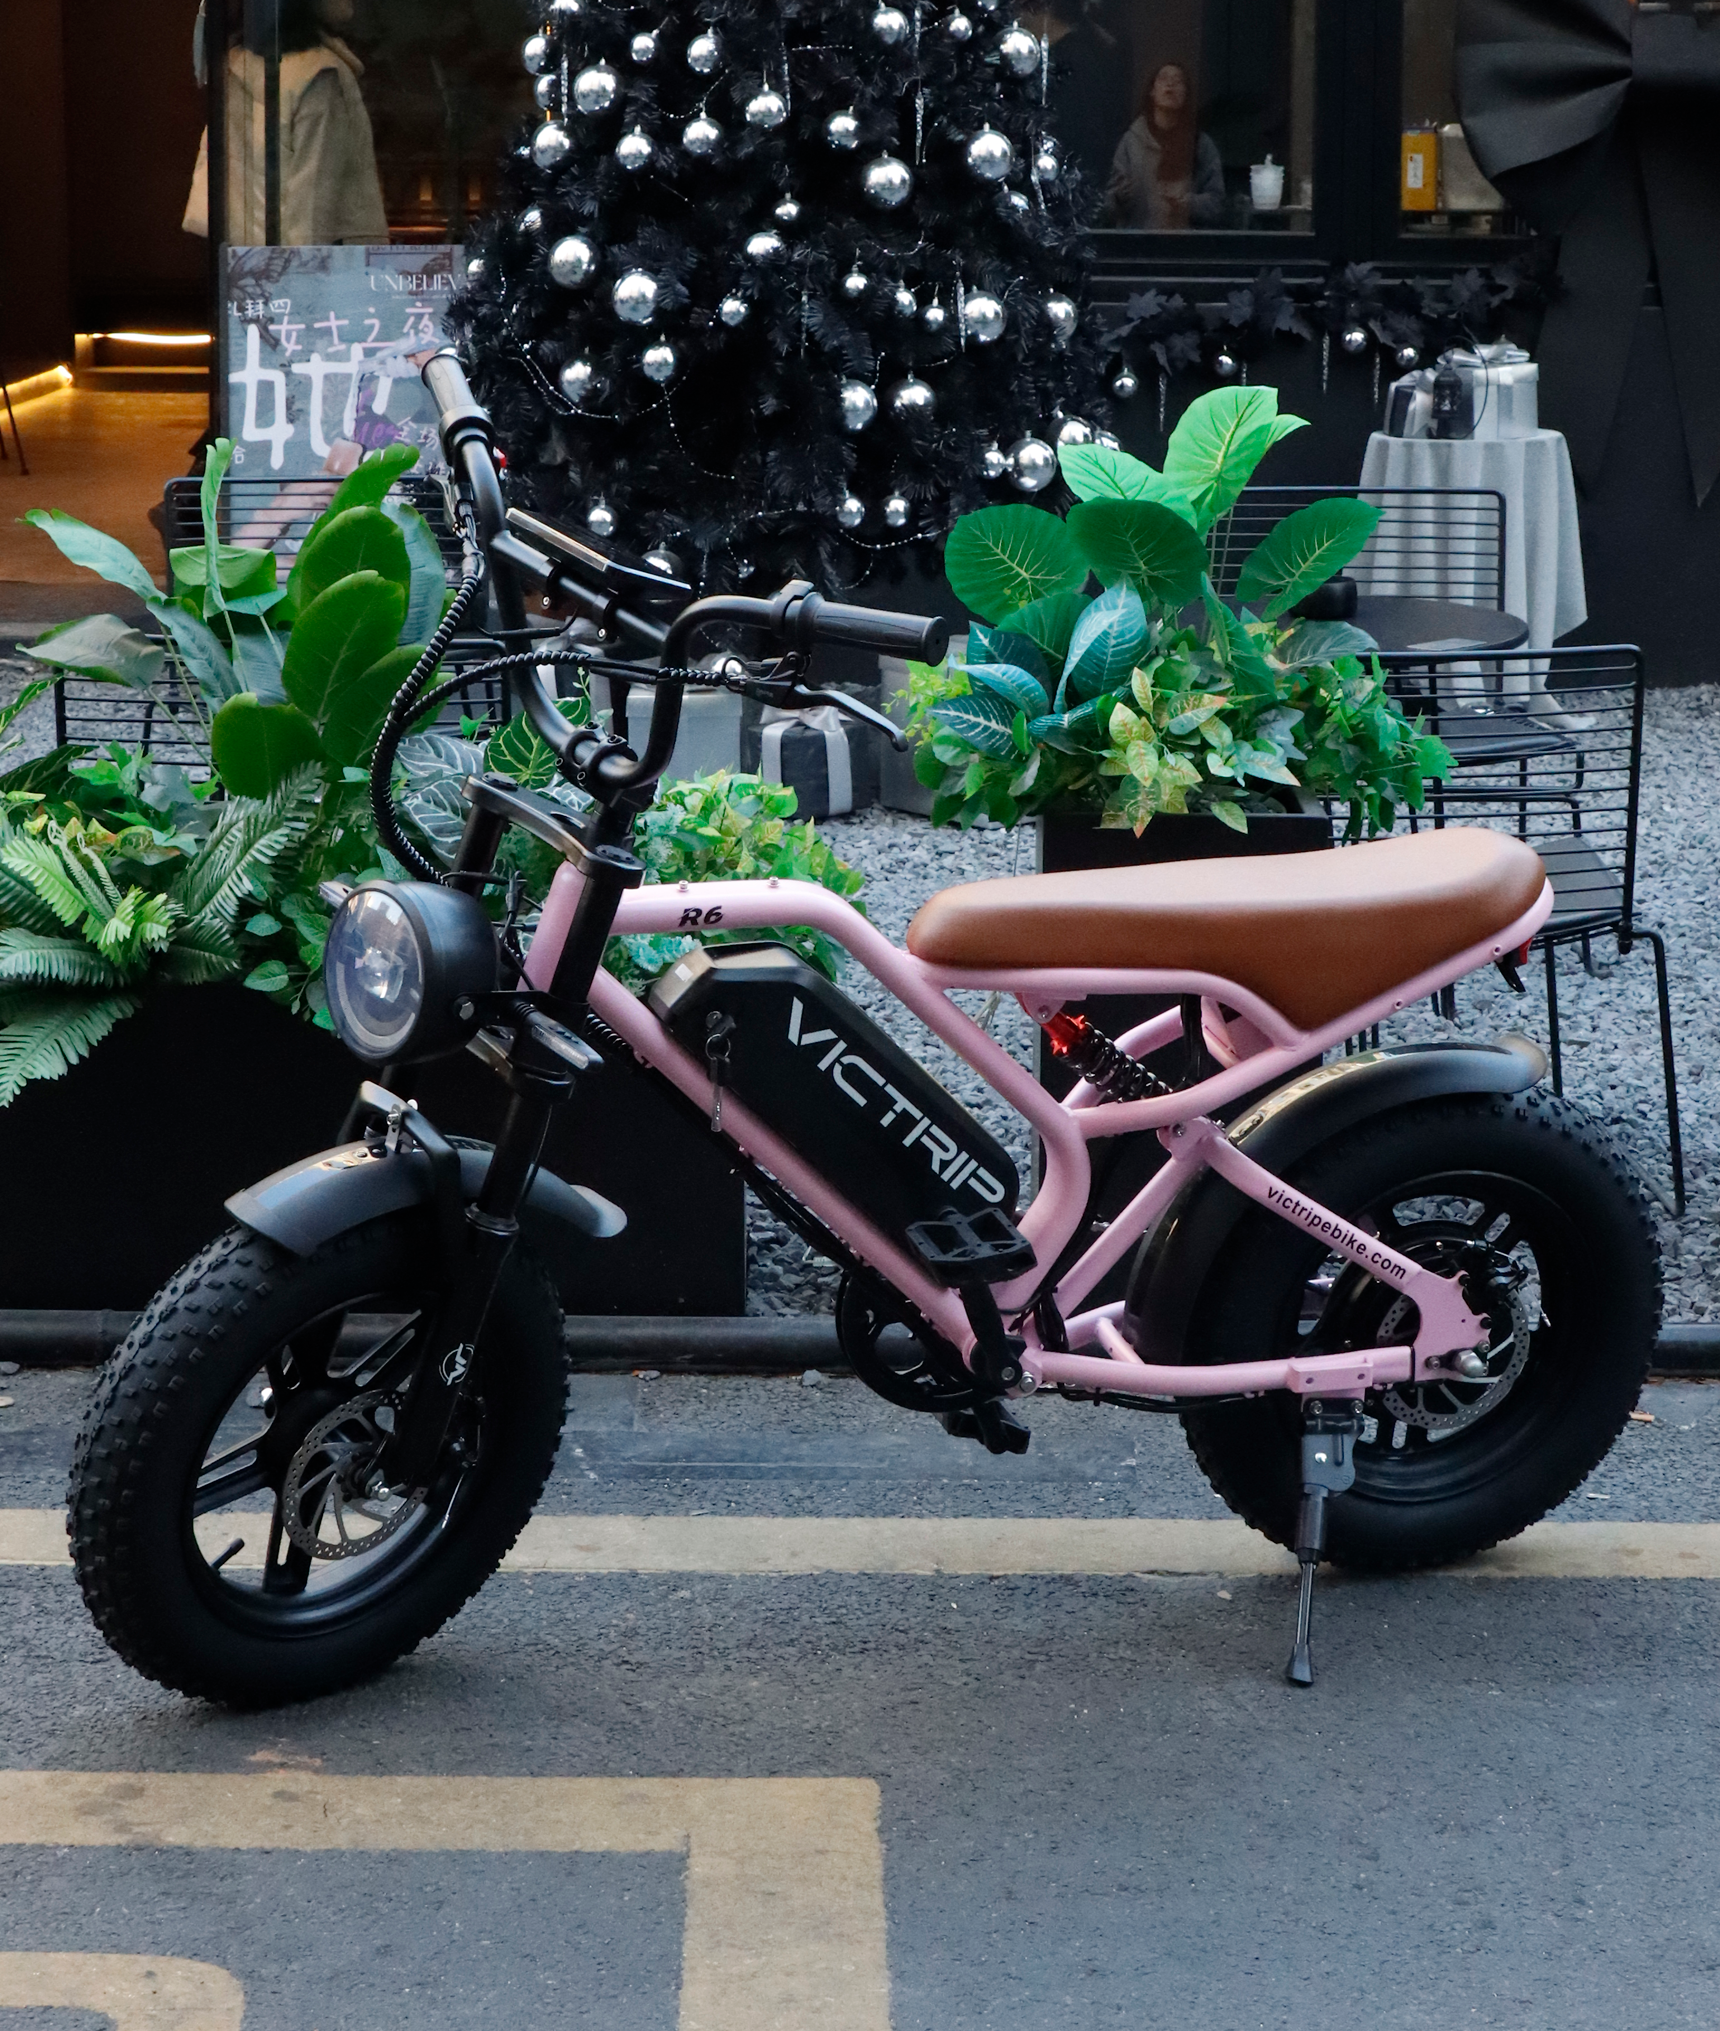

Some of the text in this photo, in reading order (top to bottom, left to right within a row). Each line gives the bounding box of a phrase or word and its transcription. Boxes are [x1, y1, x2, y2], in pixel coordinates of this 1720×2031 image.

[268, 302, 440, 357] 女士之夜
[678, 905, 724, 927] R6
[787, 996, 1006, 1204] VICTRIP
[1267, 1186, 1407, 1281] victripebike.com
